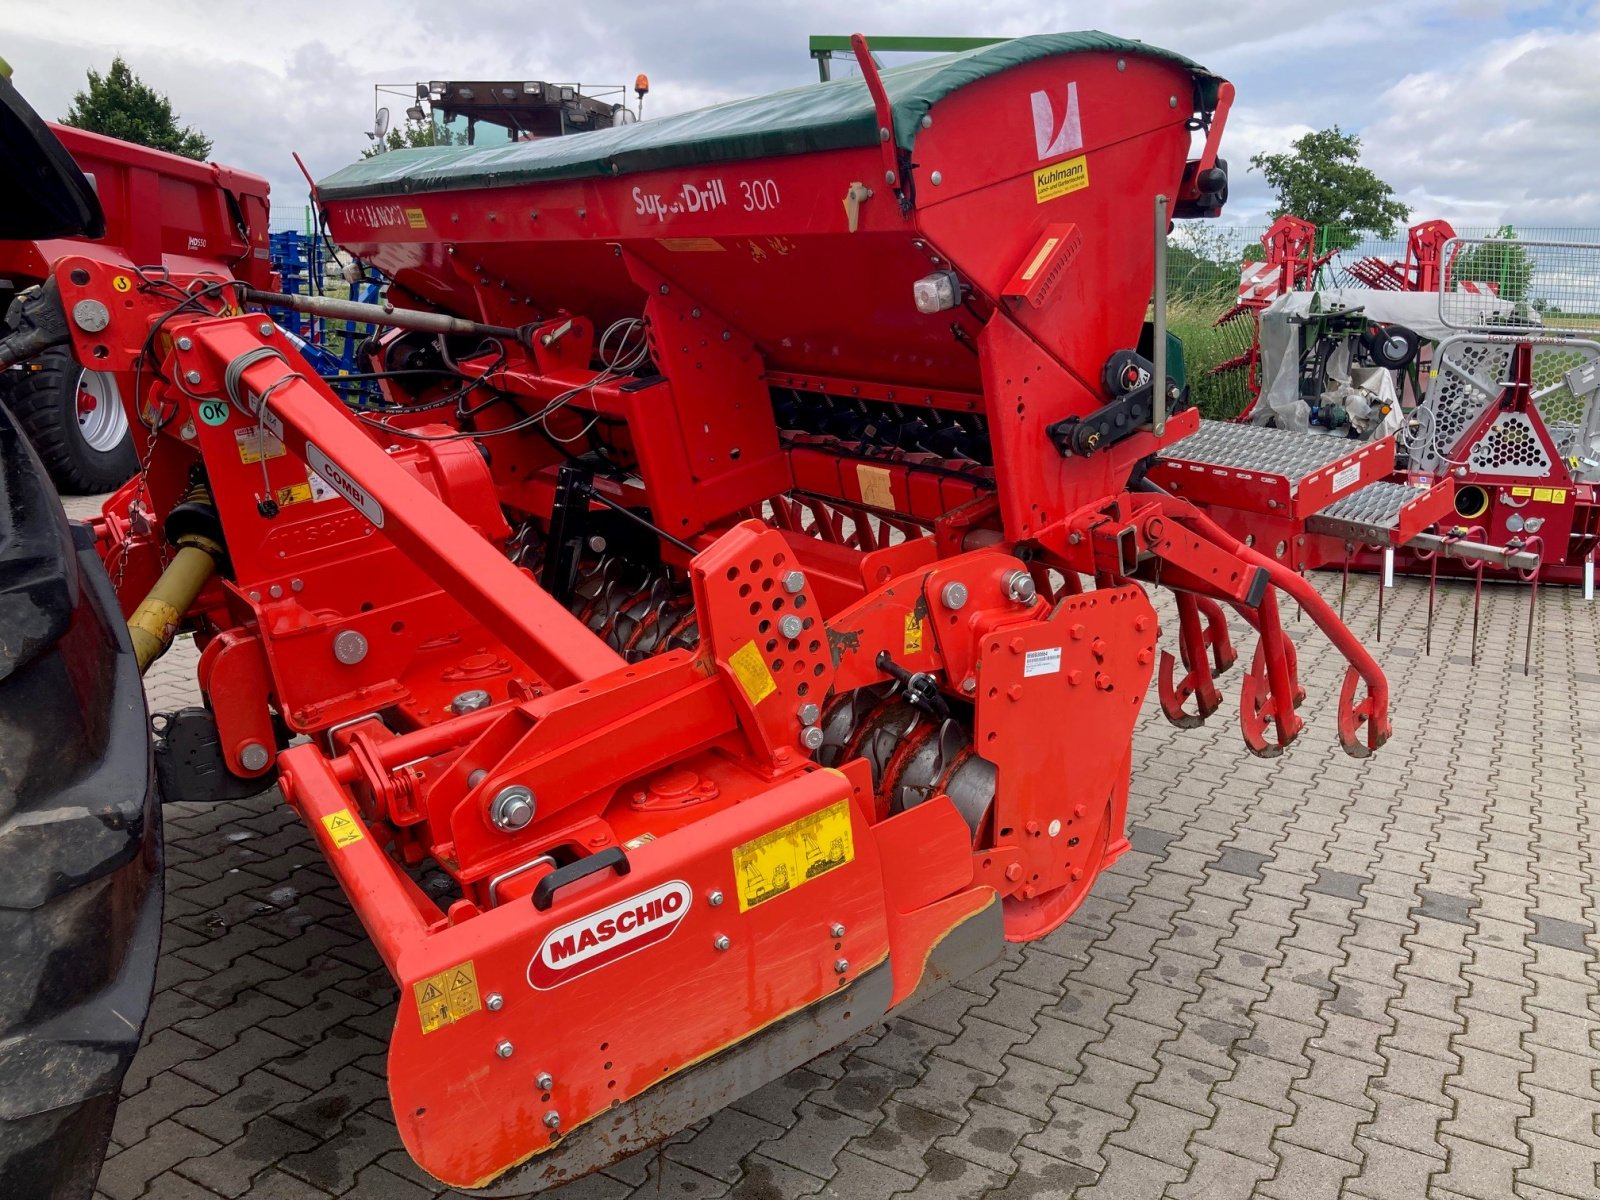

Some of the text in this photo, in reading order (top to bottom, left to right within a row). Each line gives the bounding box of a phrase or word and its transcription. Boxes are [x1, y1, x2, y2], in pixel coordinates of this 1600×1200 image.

[1037, 164, 1083, 187] Kuhlmann
[739, 179, 780, 212] 300
[203, 402, 226, 420] OK
[324, 463, 365, 506] COMBI
[550, 891, 683, 964] MASCHIO
